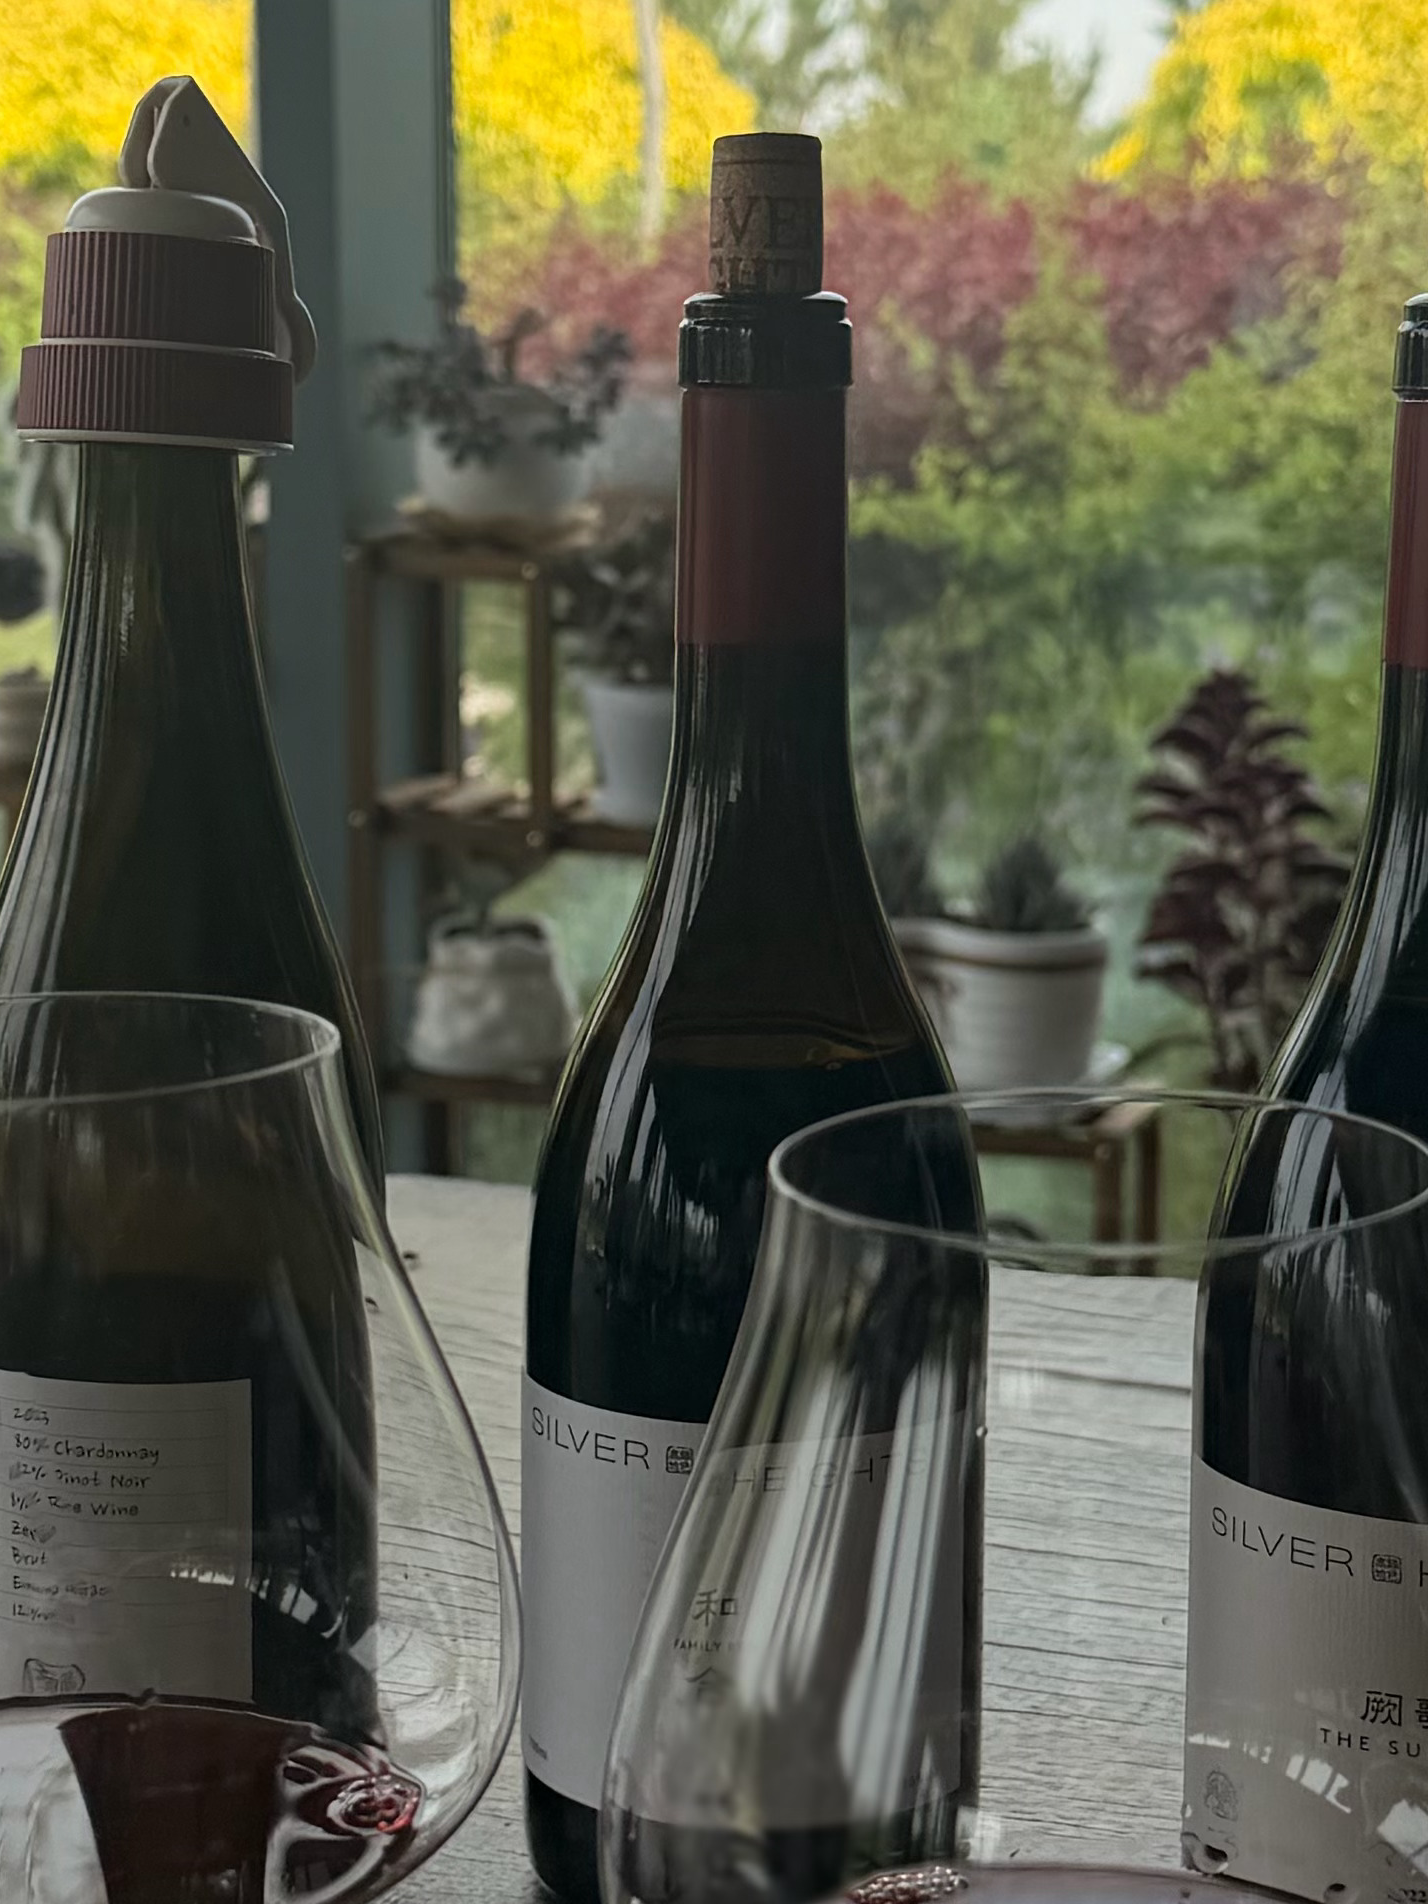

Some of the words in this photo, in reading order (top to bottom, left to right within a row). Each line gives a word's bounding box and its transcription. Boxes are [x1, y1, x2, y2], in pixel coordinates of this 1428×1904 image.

[54, 1439, 160, 1466] Chardonnay
[532, 1406, 651, 1471] SILVER
[732, 1453, 926, 1493] HEGHTS
[111, 1474, 151, 1489] Noir
[91, 1501, 140, 1517] Wine
[1211, 1507, 1355, 1577] SILVER
[11, 1546, 48, 1566] Brut
[1320, 1728, 1370, 1752] THE
